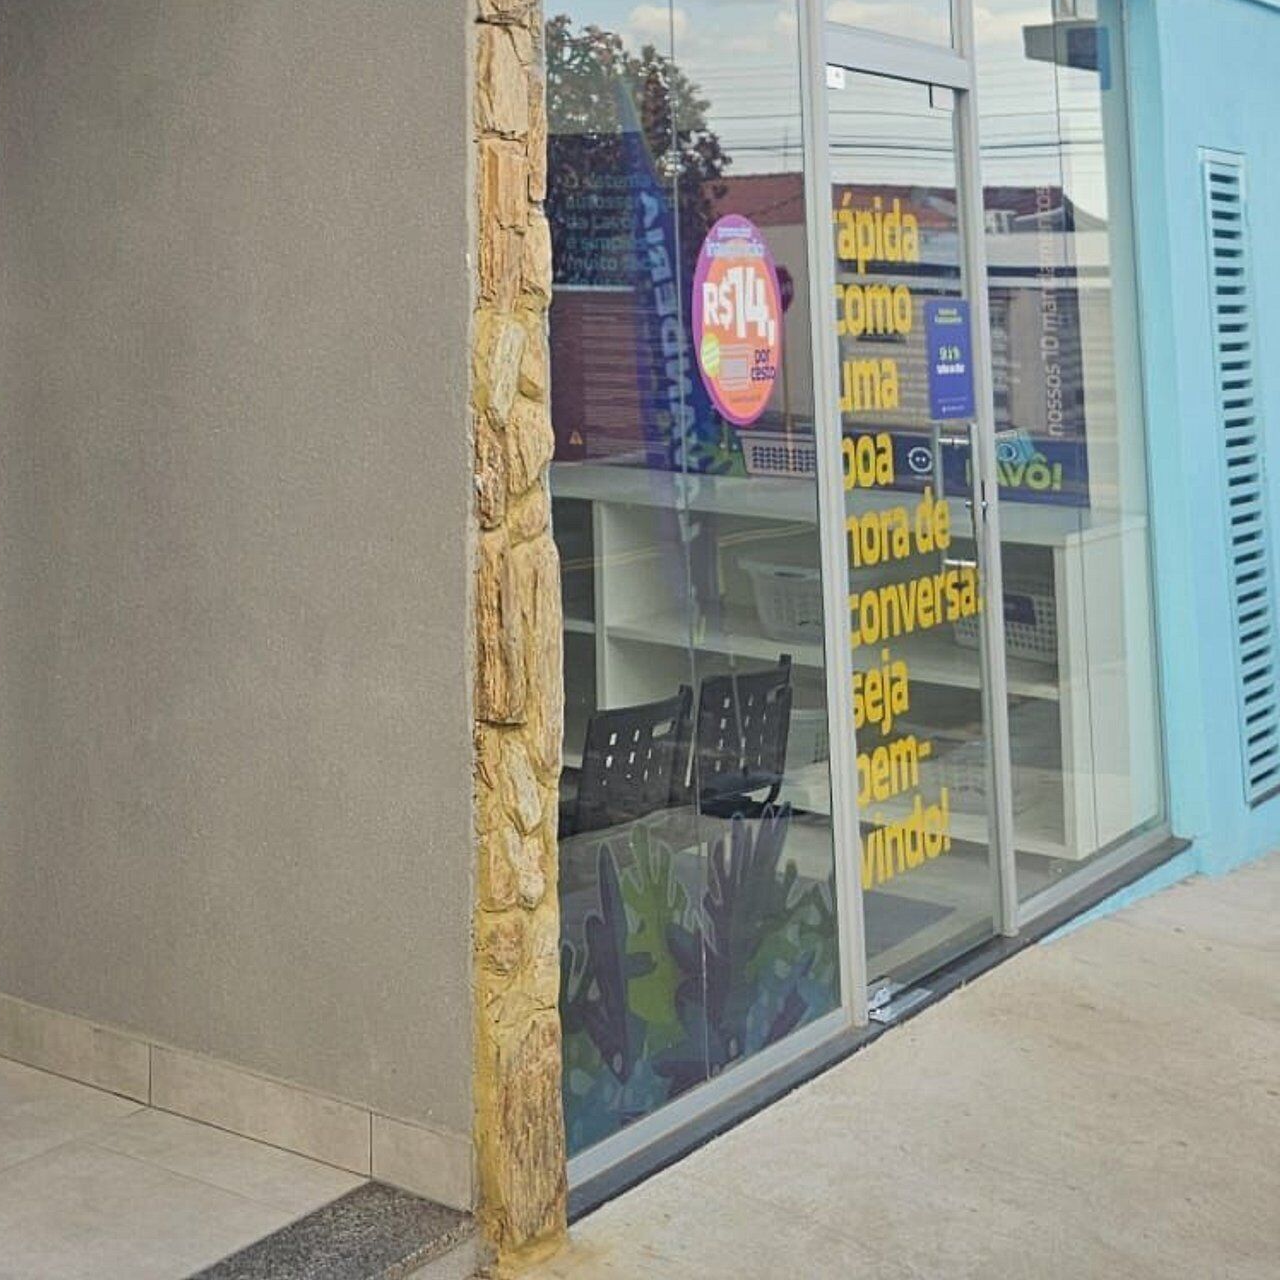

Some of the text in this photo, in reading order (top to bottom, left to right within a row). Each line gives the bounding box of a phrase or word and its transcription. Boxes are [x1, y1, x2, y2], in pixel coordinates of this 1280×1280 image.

[832, 191, 919, 276] ápida
[1041, 335, 1060, 359] 10
[1046, 365, 1063, 436] nossos
[966, 452, 1062, 491] VÔ!
[915, 486, 950, 553] de
